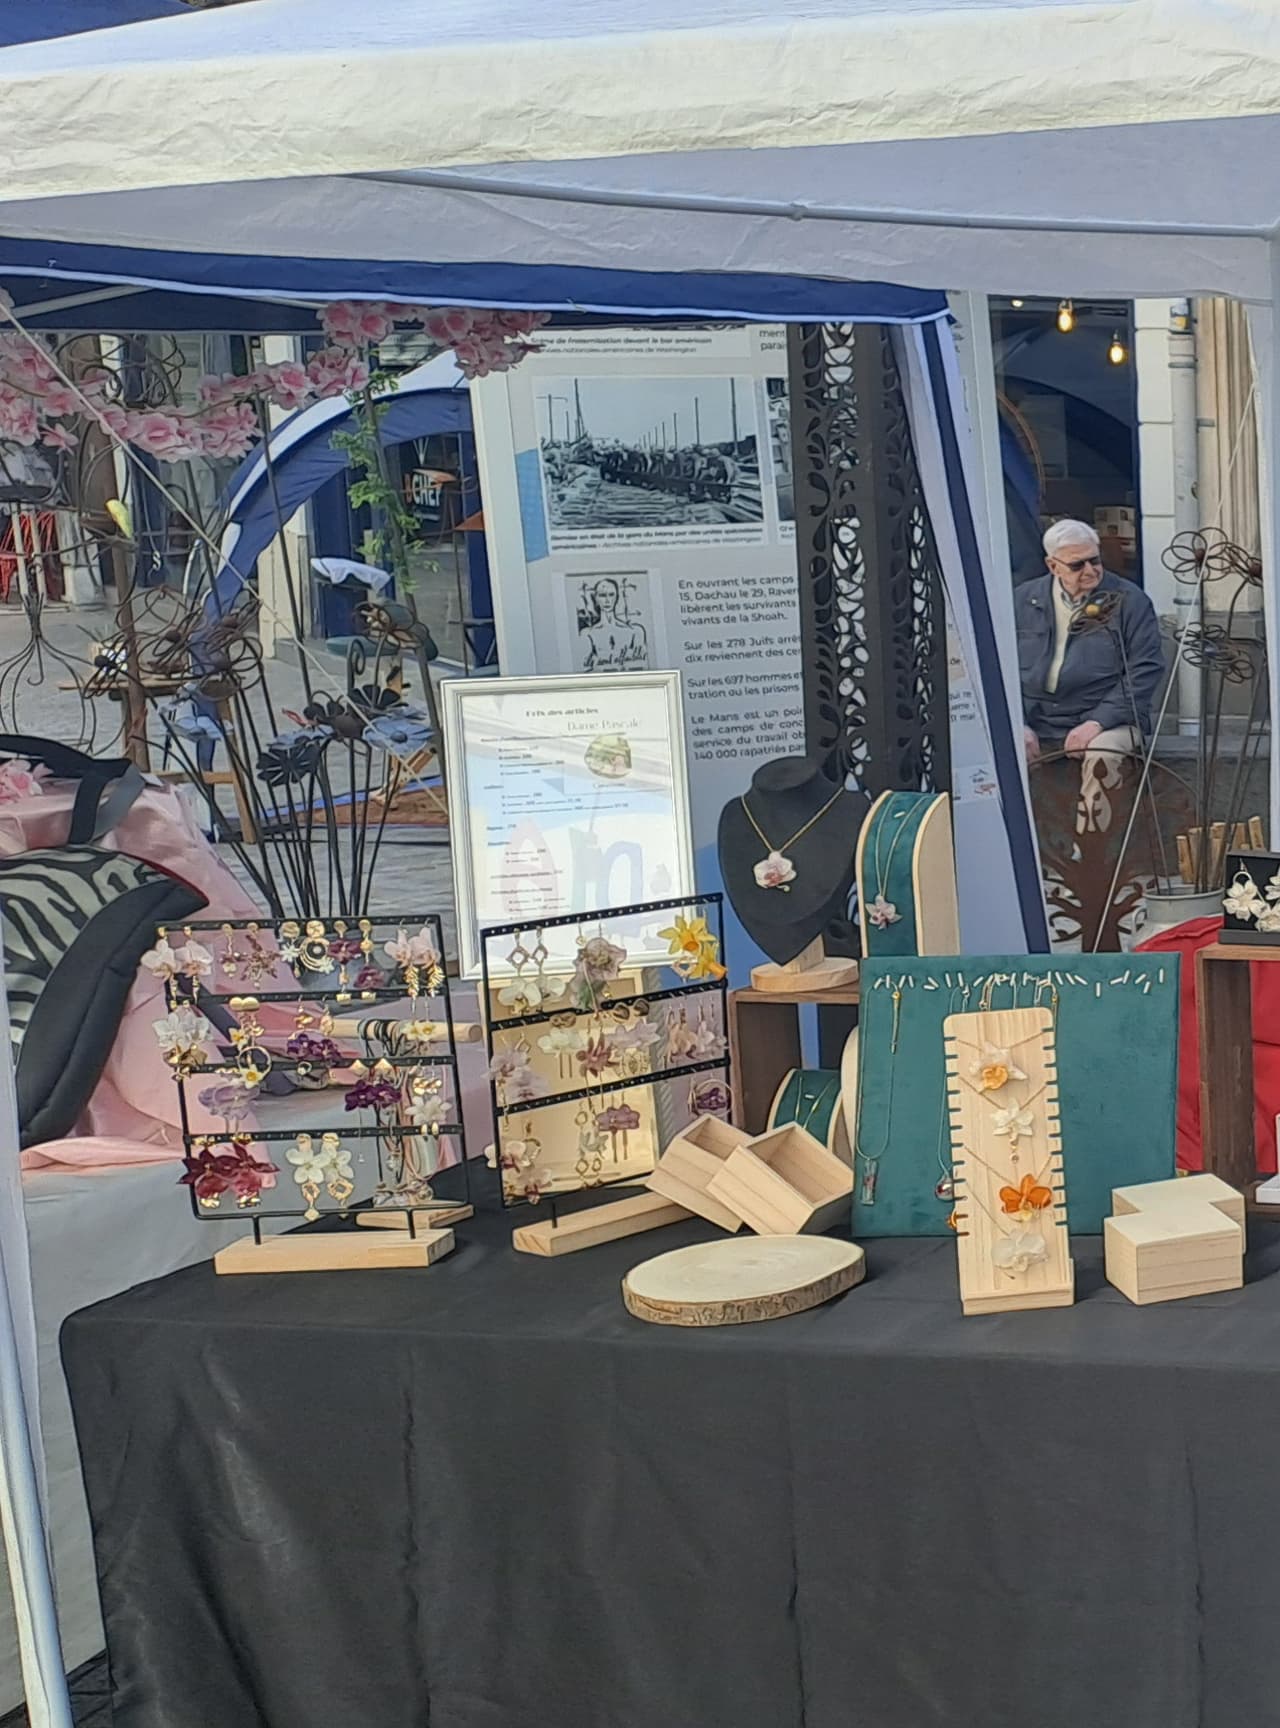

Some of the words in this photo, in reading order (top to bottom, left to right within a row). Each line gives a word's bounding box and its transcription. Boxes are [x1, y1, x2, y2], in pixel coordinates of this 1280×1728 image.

[678, 579, 693, 590] En
[696, 578, 740, 589] ouvrant
[741, 576, 757, 586] les
[759, 575, 795, 587] camps
[695, 590, 737, 601] Dachau
[739, 588, 749, 599] le
[726, 601, 741, 612] les
[743, 599, 796, 610] survivants
[681, 616, 721, 626] vivants
[722, 614, 737, 624] de
[739, 613, 750, 623] la
[684, 640, 703, 651] Sur
[706, 639, 722, 649] les
[749, 636, 775, 647] Juifs
[685, 653, 703, 663] dix
[705, 649, 763, 662] reviennent
[765, 647, 785, 658] des
[687, 678, 705, 688] Sur
[707, 676, 724, 686] les
[745, 673, 792, 683] hommes
[688, 689, 726, 700] tration
[728, 687, 743, 697] ou
[744, 686, 760, 696] les
[762, 684, 800, 695] prisons
[690, 716, 704, 725] Le
[709, 713, 739, 722] Mans
[743, 710, 760, 720] est
[764, 709, 779, 718] un
[691, 727, 712, 737] des
[718, 724, 754, 735] camps
[760, 721, 775, 731] de
[693, 737, 733, 749] service
[736, 736, 751, 745] du
[755, 731, 788, 743] travail
[694, 750, 713, 760] 140
[715, 748, 738, 759] 000
[739, 744, 786, 757] rapatriés
